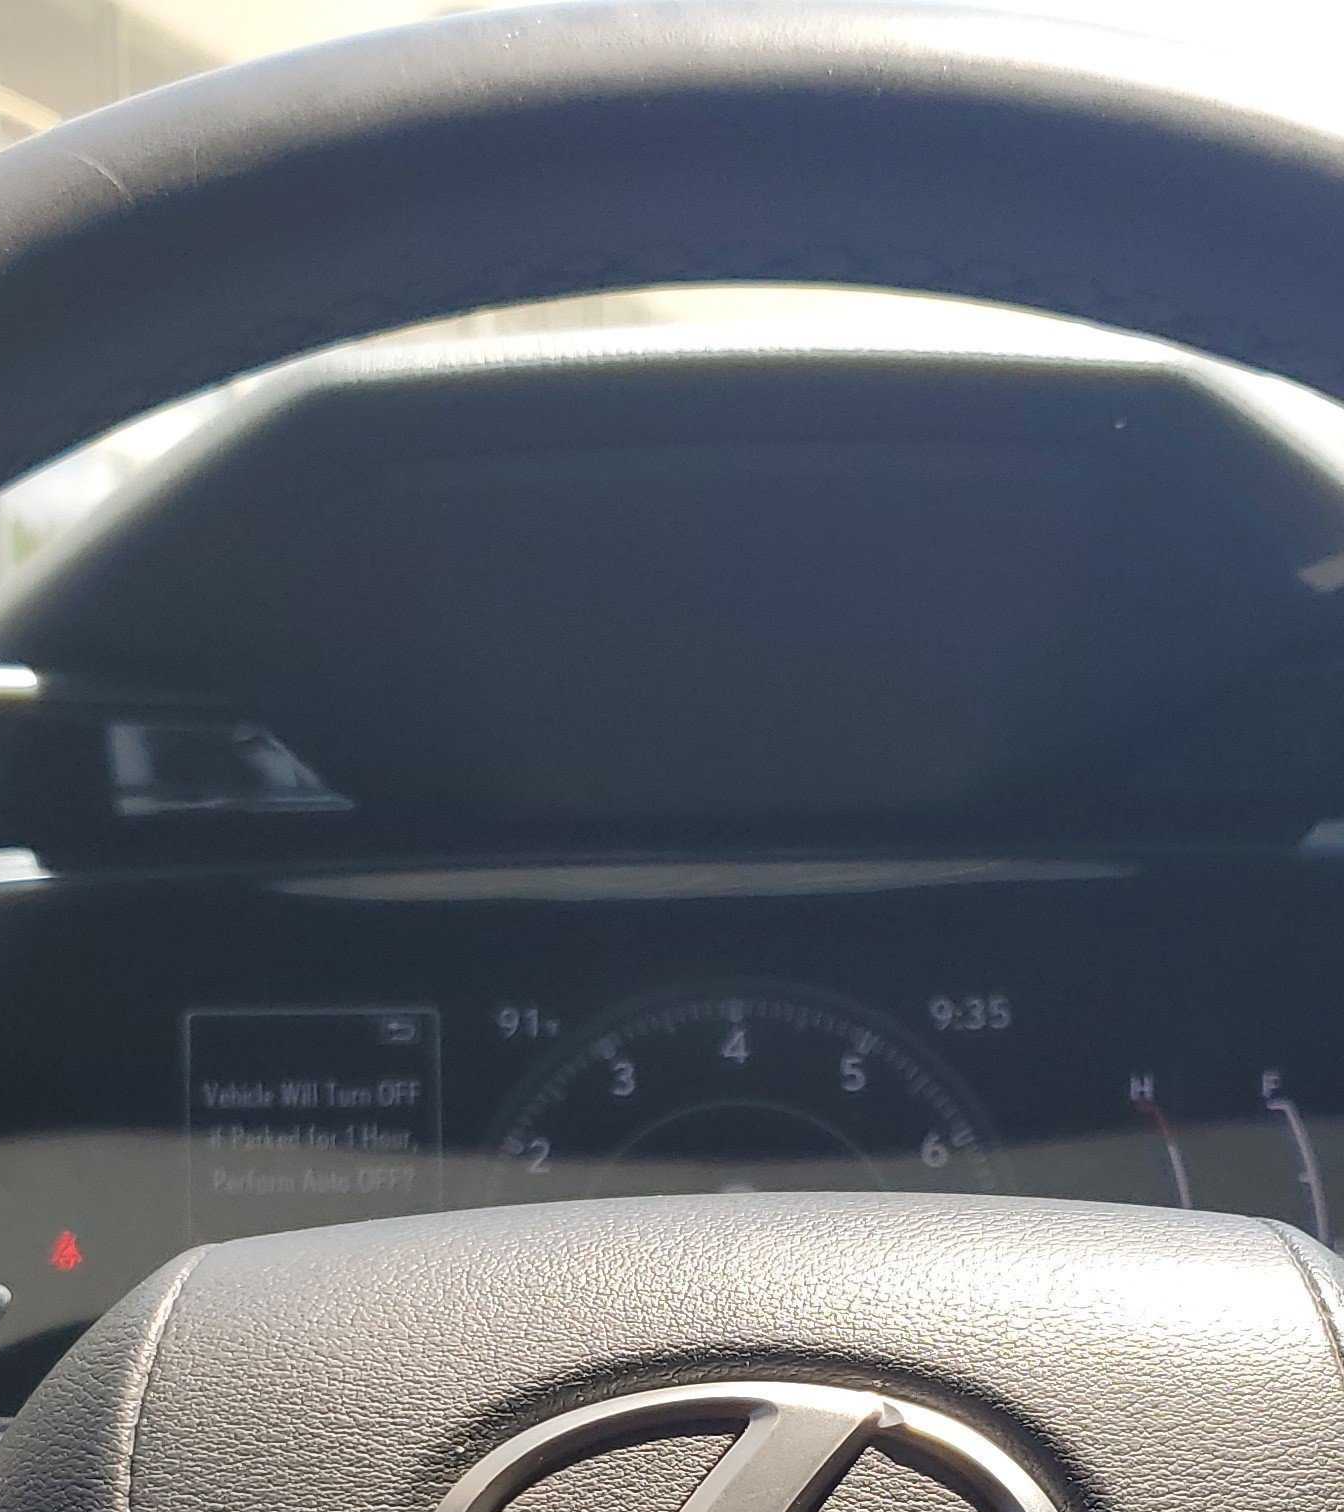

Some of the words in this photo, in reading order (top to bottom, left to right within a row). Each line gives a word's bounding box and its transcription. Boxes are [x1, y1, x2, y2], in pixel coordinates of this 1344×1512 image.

[928, 995, 1011, 1031] 9:35
[722, 1027, 748, 1063] 4
[613, 1062, 637, 1096] 3
[841, 1056, 866, 1092] 5
[1129, 1073, 1154, 1100] H
[203, 1081, 274, 1108] Vehicle
[280, 1080, 319, 1107] Will
[327, 1080, 372, 1107] Turn
[377, 1079, 421, 1107] OFF
[229, 1124, 301, 1151] Parked
[308, 1123, 337, 1150] for
[921, 1134, 948, 1167] 6
[529, 1139, 552, 1174] 2
[212, 1169, 295, 1195] Perform
[303, 1169, 351, 1194] Auto
[357, 1167, 416, 1194] OFF?
